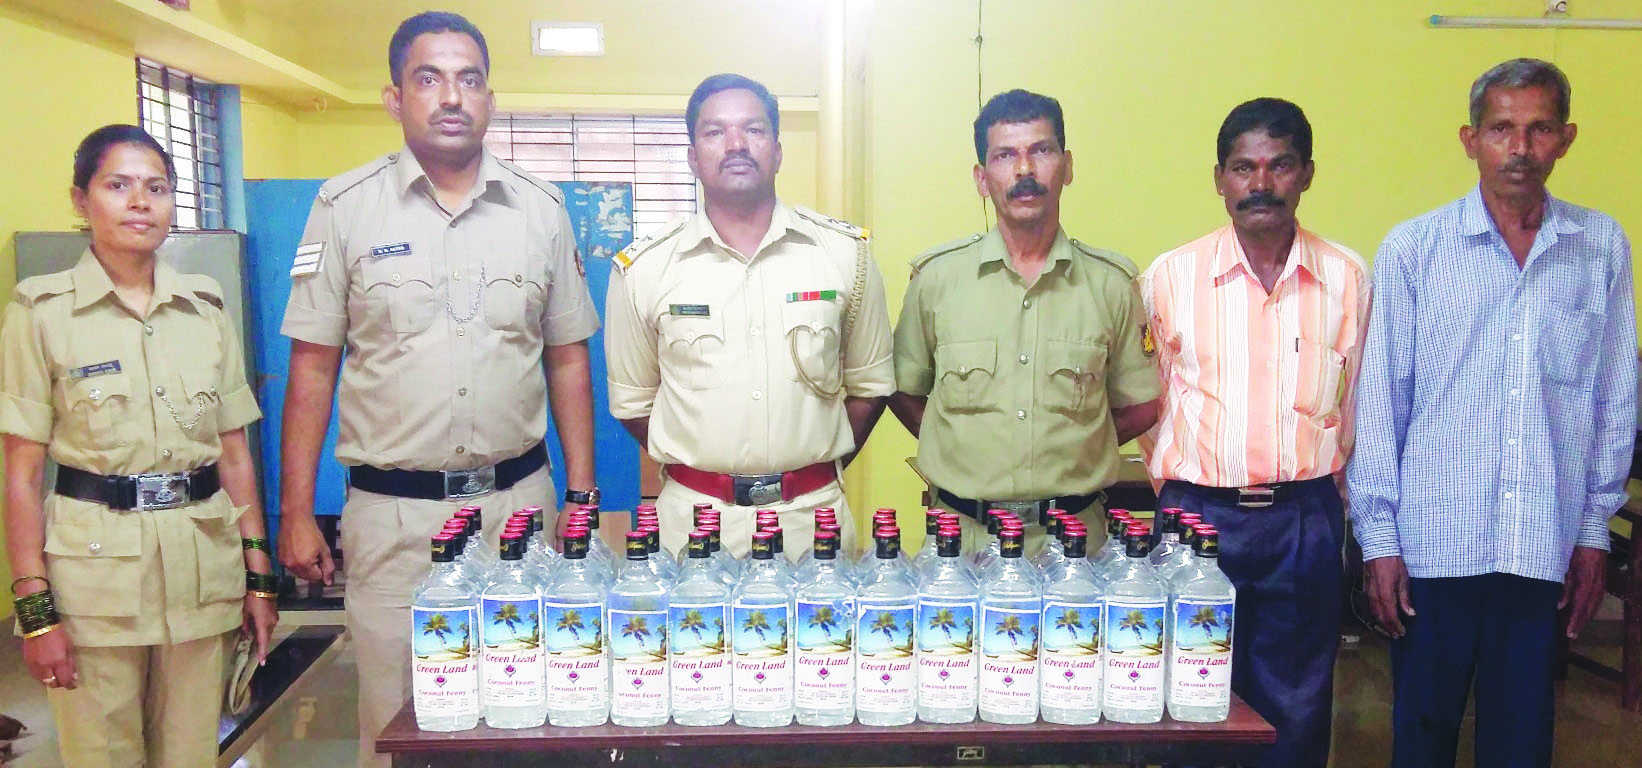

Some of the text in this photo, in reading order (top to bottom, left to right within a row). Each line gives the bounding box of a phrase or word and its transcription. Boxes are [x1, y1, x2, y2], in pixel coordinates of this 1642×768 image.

[486, 654, 510, 662] Green
[799, 656, 850, 666] Green Land
[920, 658, 970, 668] Green Land
[1044, 658, 1070, 668] Green
[1178, 656, 1228, 666] Green Land
[416, 664, 468, 674] Green Land
[549, 660, 600, 669] Green Land
[673, 660, 697, 669] Green
[736, 660, 786, 670] Green Land
[860, 662, 911, 671] Green Land
[984, 663, 1034, 675] Green Land
[1109, 659, 1160, 669] Green Land
[640, 667, 664, 676] Land
